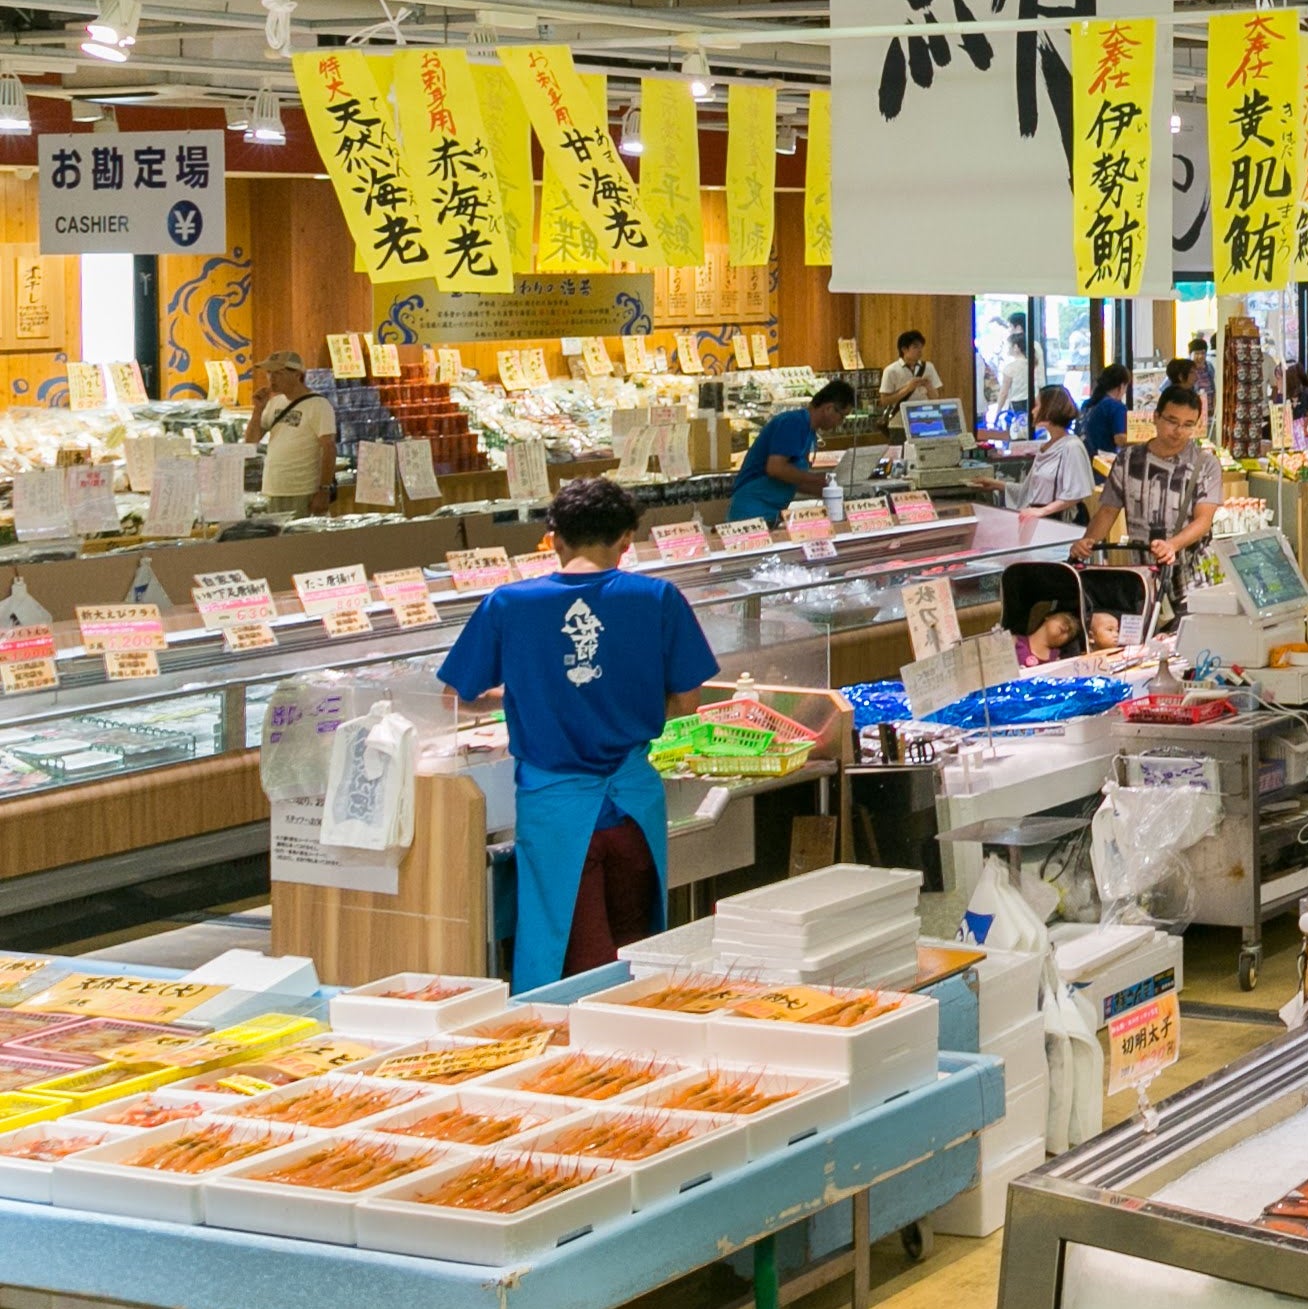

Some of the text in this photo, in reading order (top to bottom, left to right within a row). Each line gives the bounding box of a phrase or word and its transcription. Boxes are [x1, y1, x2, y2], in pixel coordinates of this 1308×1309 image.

[52, 145, 210, 191] お勘定場
[55, 216, 130, 234] CASHIER
[326, 98, 429, 271] 天然海老
[427, 136, 499, 279] 赤海老
[560, 129, 649, 249] 甘海老
[1085, 99, 1142, 290] 伊勢鮪
